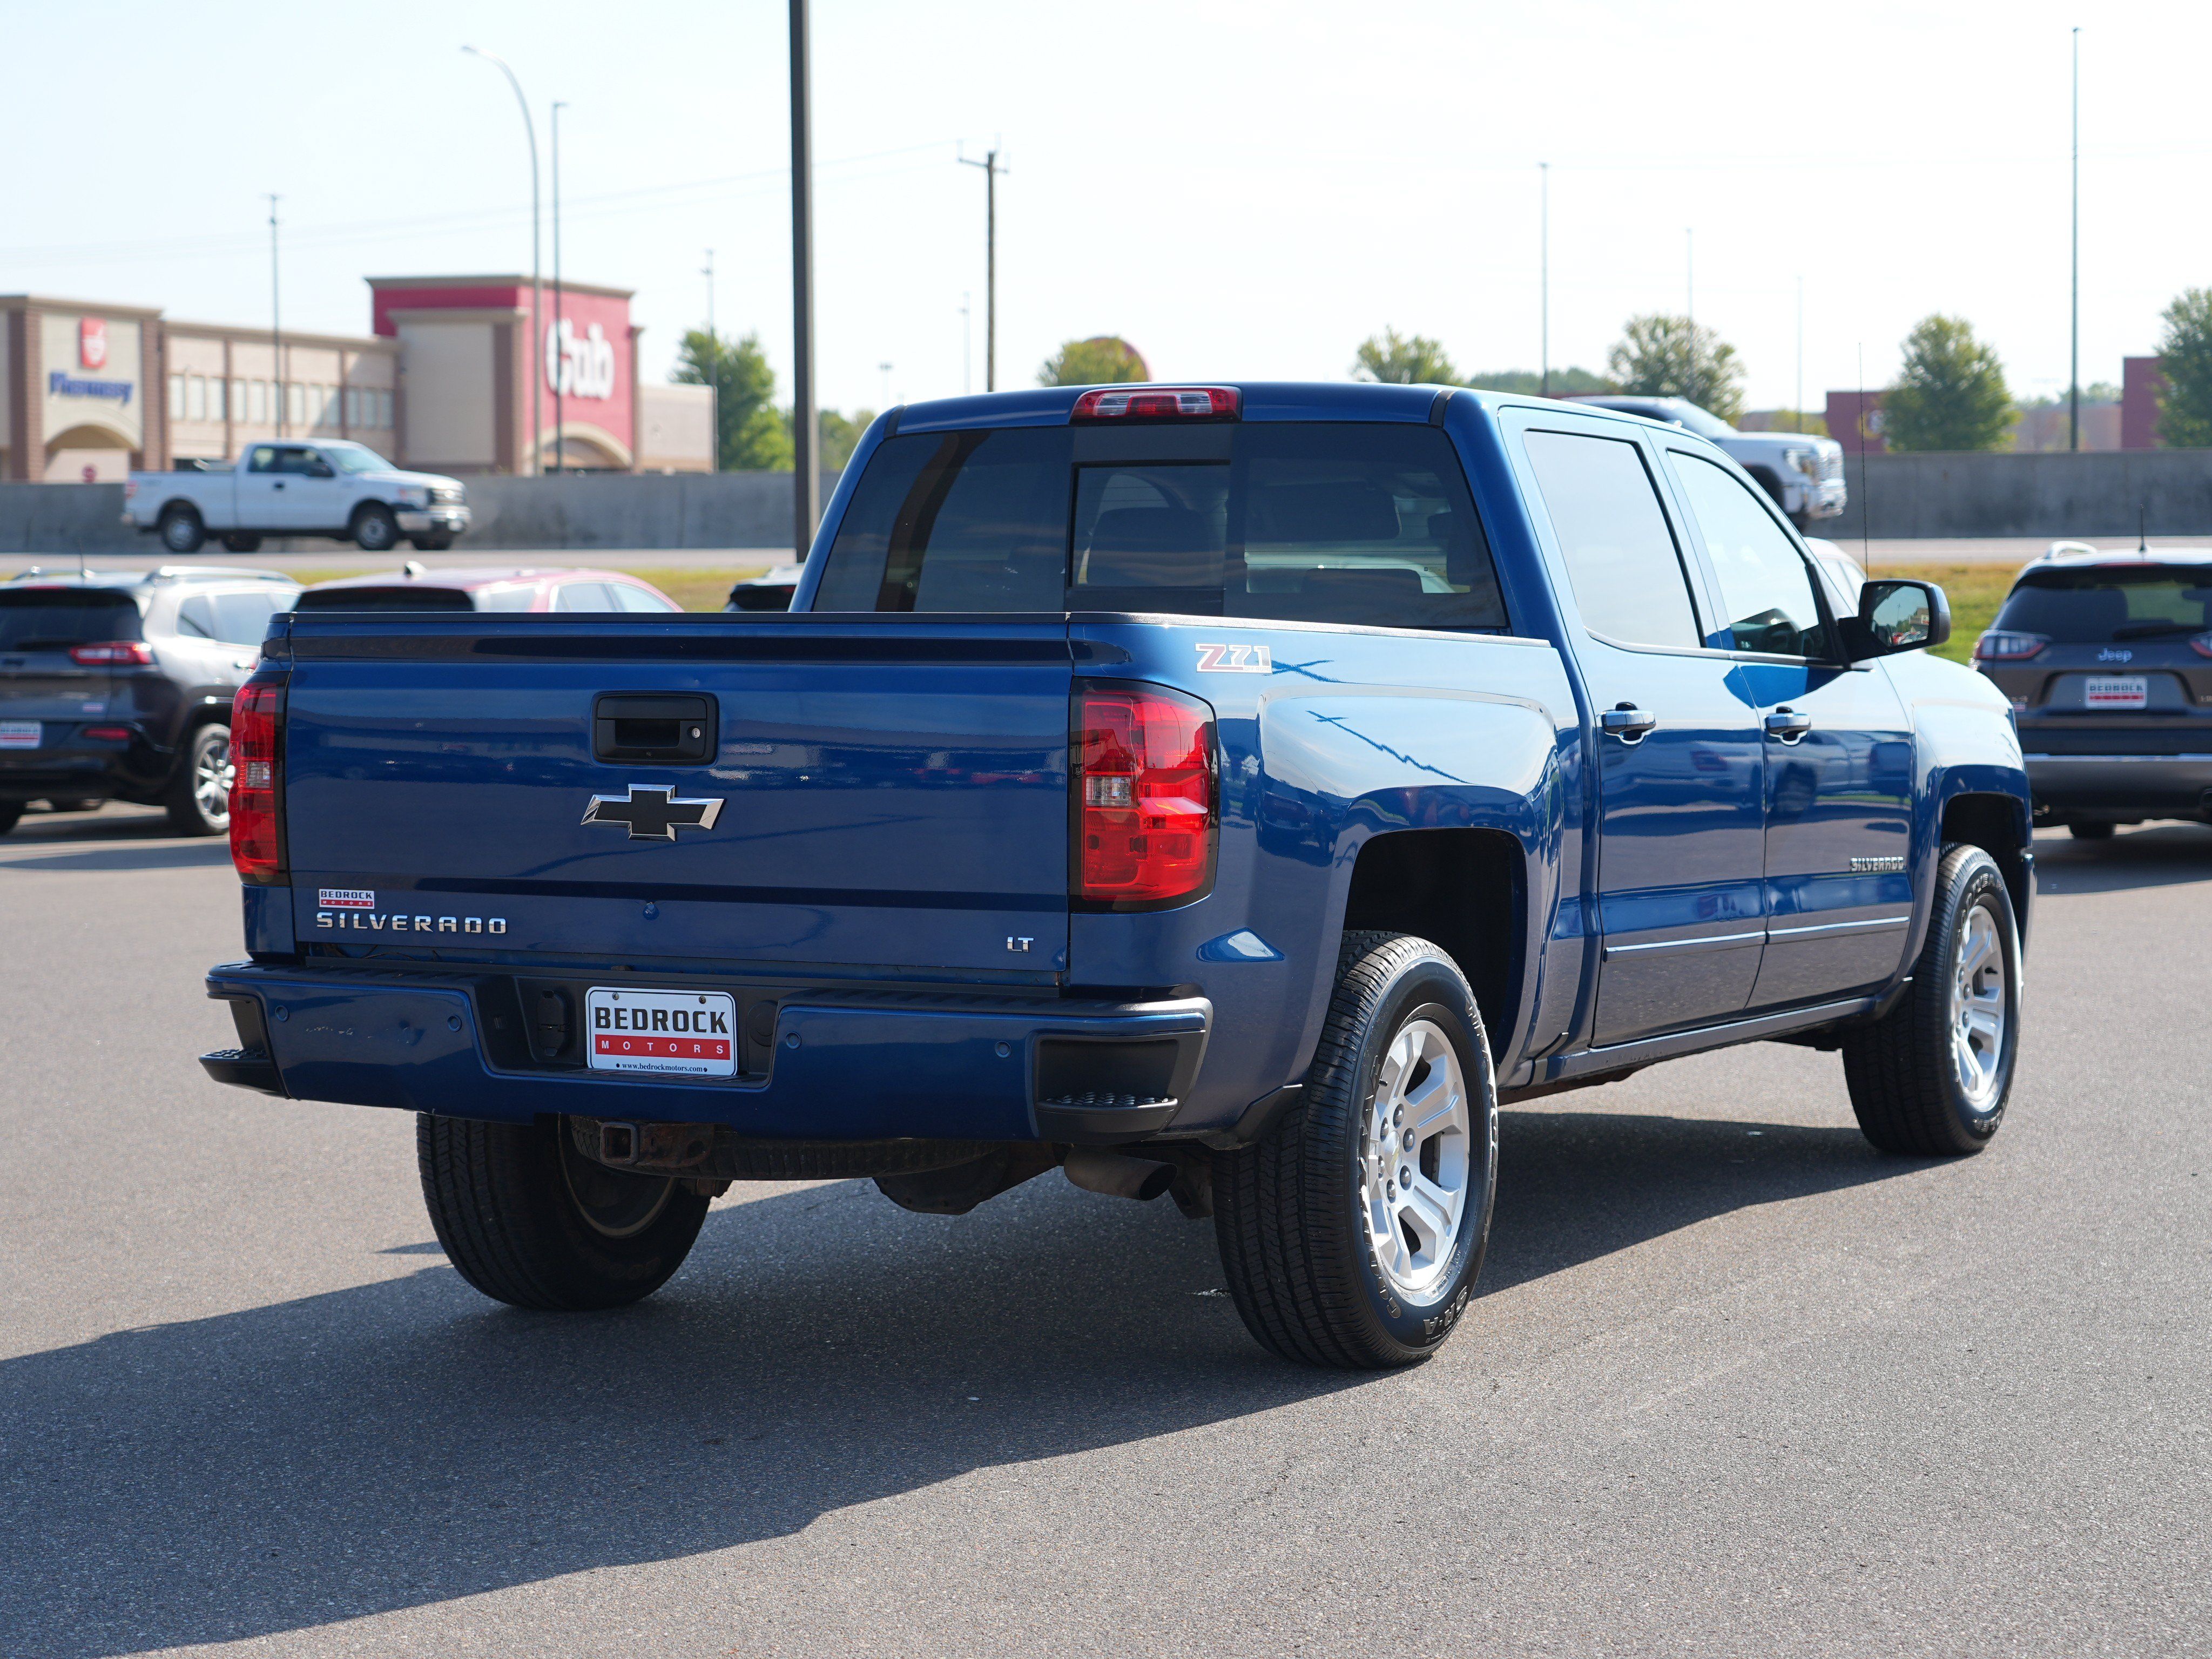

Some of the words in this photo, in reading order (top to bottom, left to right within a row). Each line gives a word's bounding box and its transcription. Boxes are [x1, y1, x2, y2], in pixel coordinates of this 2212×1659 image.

[547, 318, 615, 399] Cub
[1195, 643, 1271, 673] Z71
[2098, 648, 2133, 663] Jeep
[1850, 856, 1904, 872] SILVERADO
[321, 891, 373, 899] BEDROCK
[316, 912, 507, 934] SILVERADO
[1007, 936, 1034, 953] LT
[595, 1007, 729, 1034] BEDROCK
[601, 1040, 724, 1054] MOTORS
[622, 1062, 703, 1073] www.bedrockmotors.com
